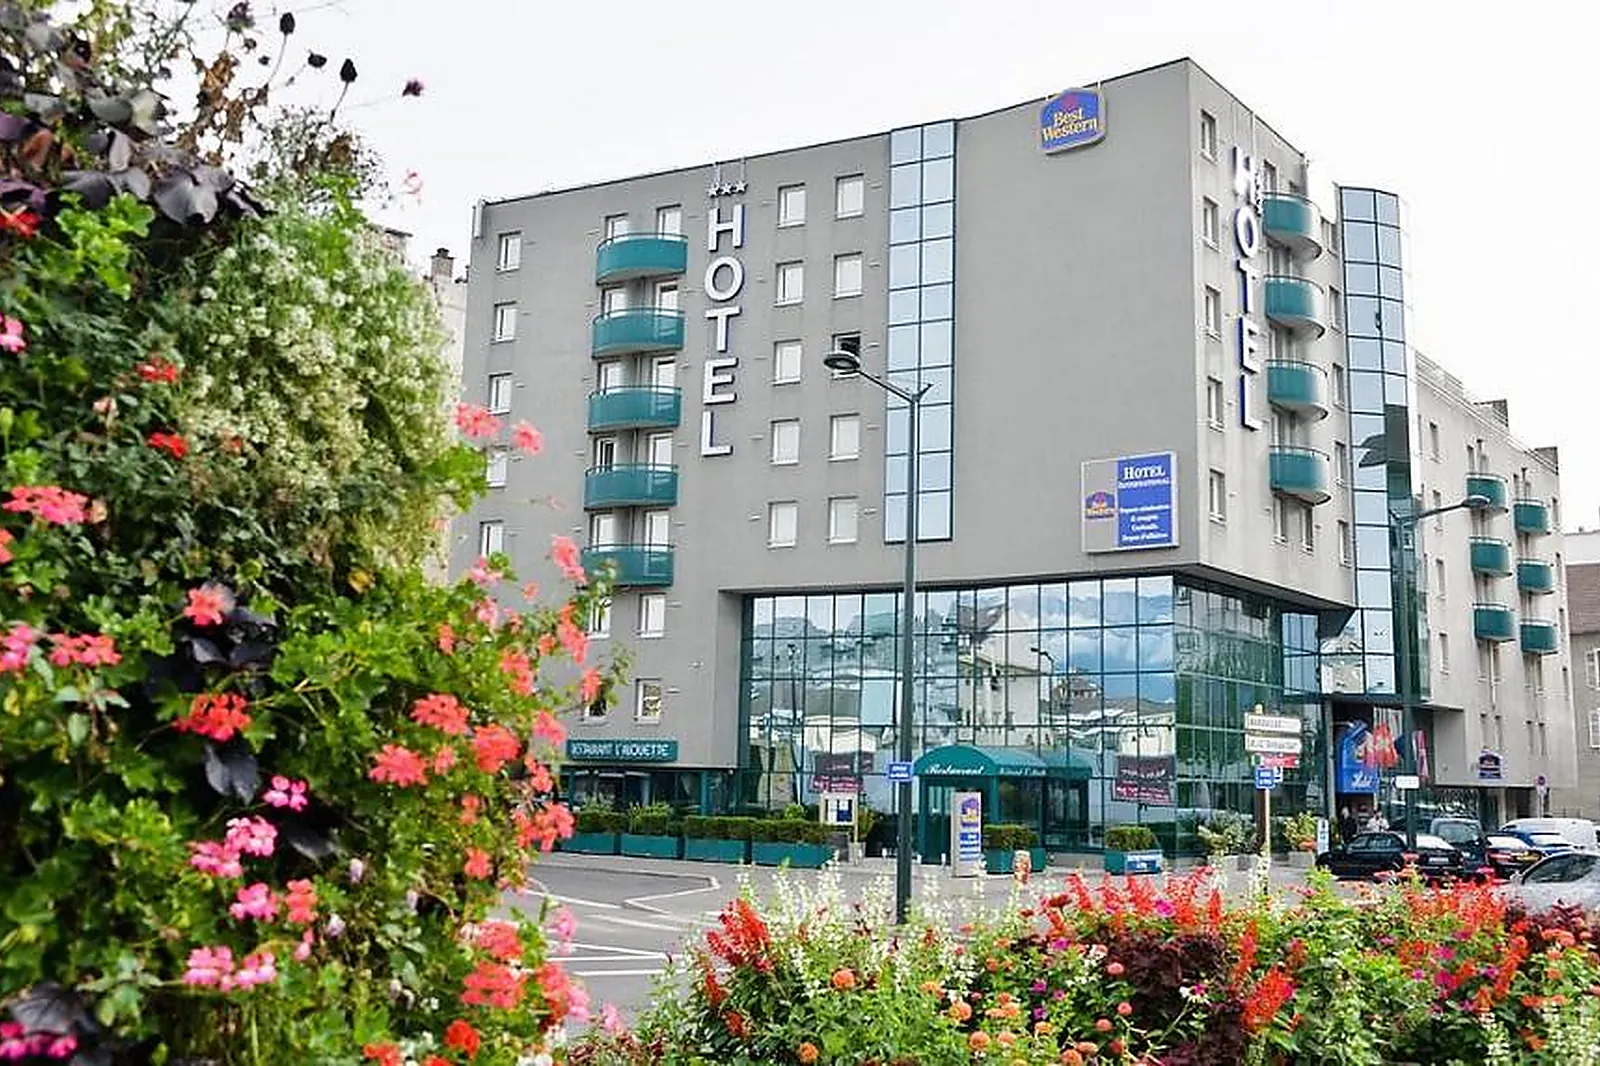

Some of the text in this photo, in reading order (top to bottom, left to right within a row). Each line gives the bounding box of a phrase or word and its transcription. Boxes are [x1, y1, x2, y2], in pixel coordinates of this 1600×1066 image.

[1043, 118, 1097, 141] Western
[1054, 107, 1082, 128] Best
[701, 204, 745, 456] HOTEL
[1233, 146, 1261, 430] HOTEL
